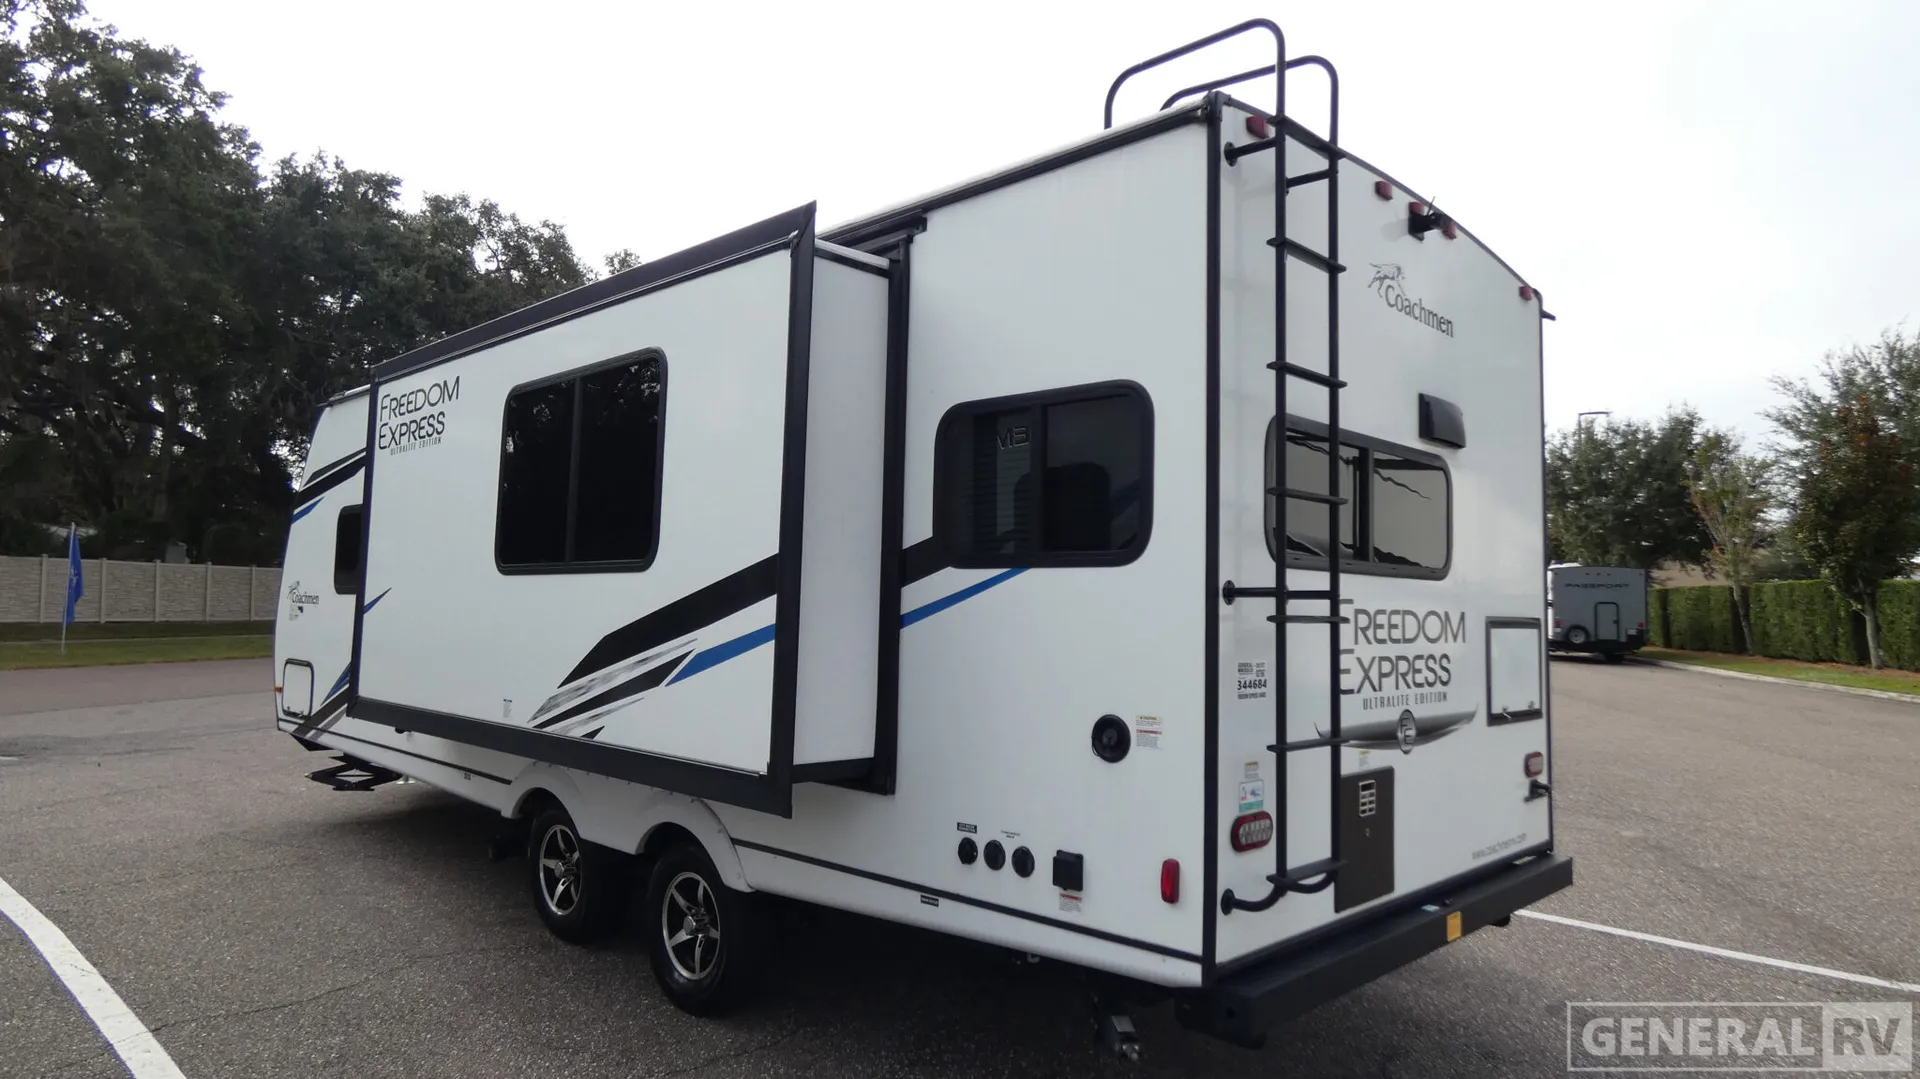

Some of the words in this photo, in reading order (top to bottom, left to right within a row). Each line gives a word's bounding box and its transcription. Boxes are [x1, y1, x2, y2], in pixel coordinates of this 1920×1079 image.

[1385, 284, 1454, 338] Coachmen
[380, 376, 460, 422] FREEDOM
[379, 411, 446, 450] EXPRESS
[419, 437, 442, 449] EDITION
[291, 591, 319, 606] Coachmen
[1237, 678, 1267, 691] 344684
[1362, 694, 1411, 711] ULTRALITE
[1414, 691, 1448, 706] EDITION
